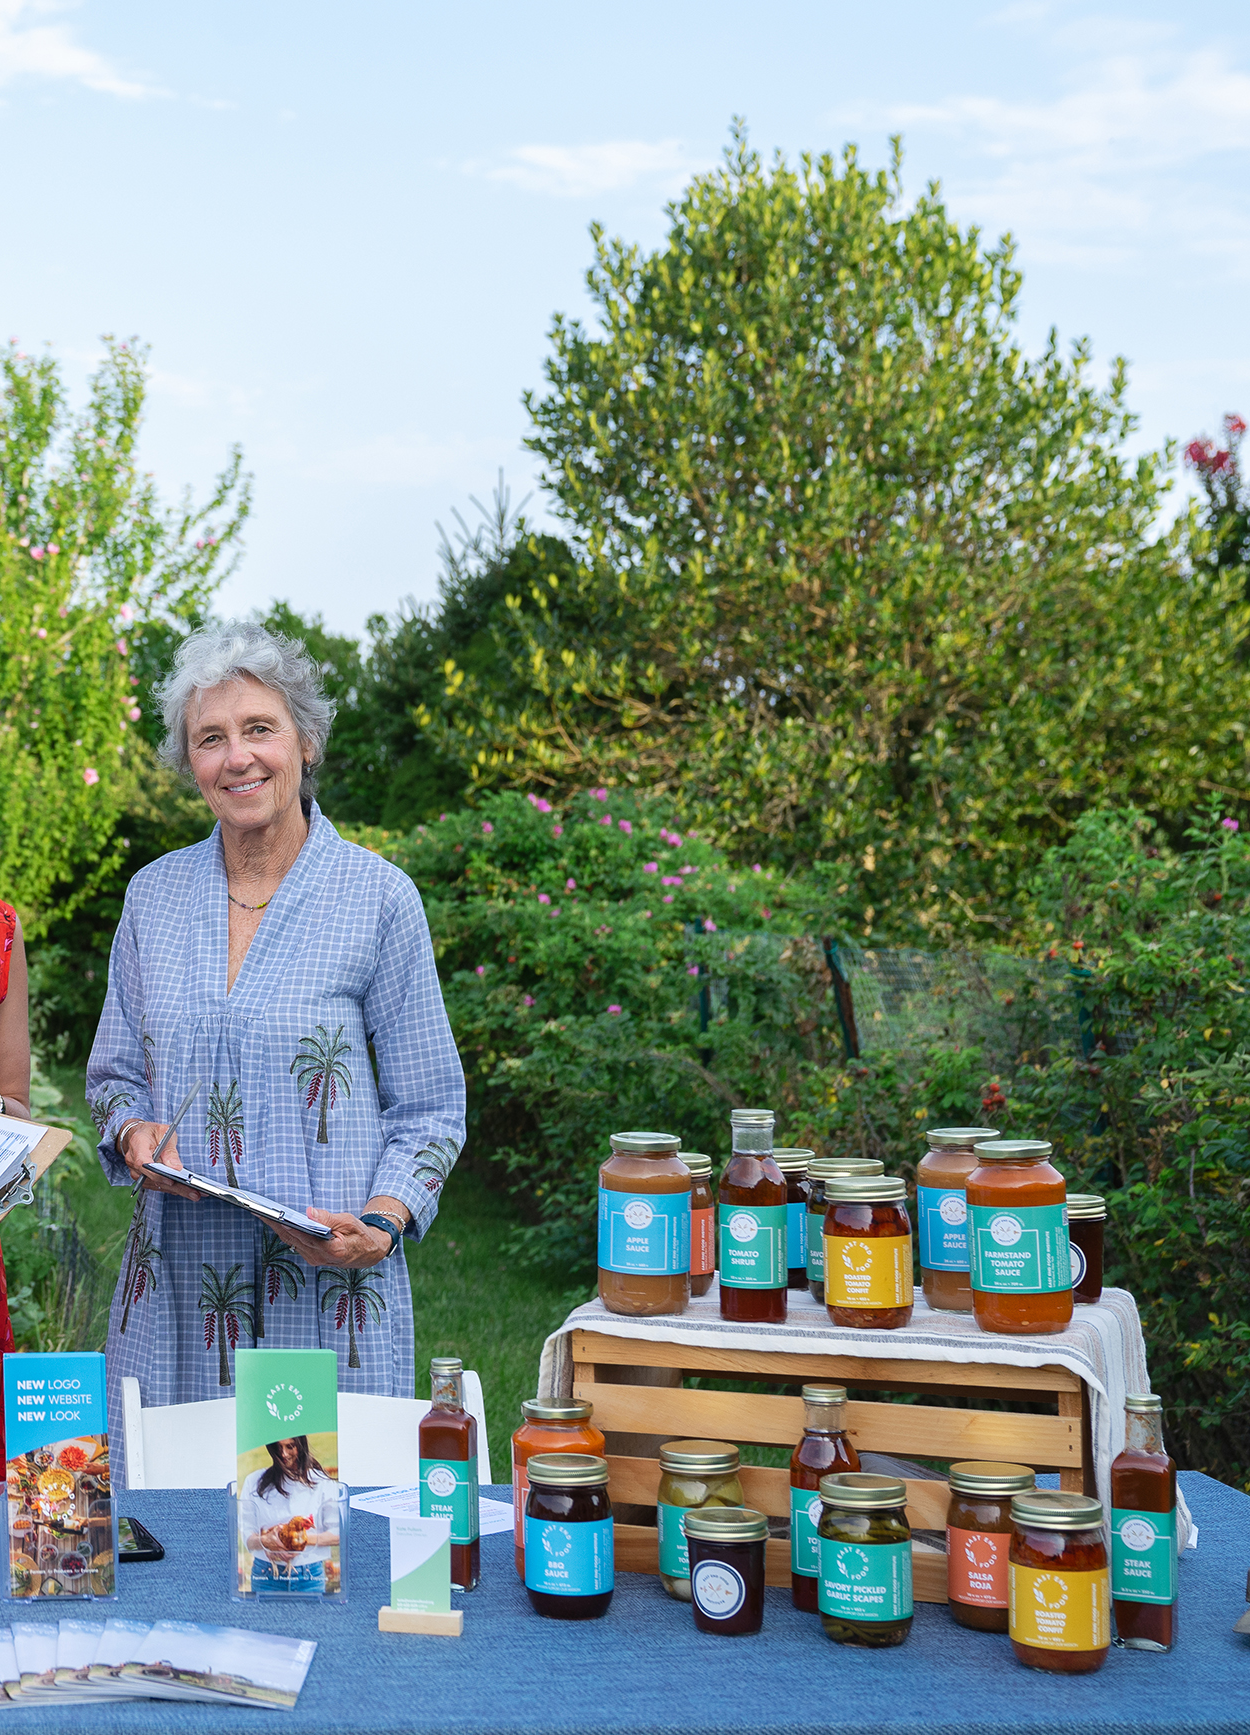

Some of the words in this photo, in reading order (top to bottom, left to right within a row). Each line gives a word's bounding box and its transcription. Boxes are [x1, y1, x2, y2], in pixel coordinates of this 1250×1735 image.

[626, 1237, 649, 1245] APPLE
[943, 1233, 966, 1241] APPLE
[626, 1245, 650, 1253] SAUCE
[842, 1241, 857, 1254] EAST
[859, 1242, 872, 1255] END
[943, 1241, 967, 1249] SAUCE
[728, 1249, 759, 1258] TOMATO
[984, 1251, 1031, 1259] FARMSTAND
[731, 1258, 756, 1266] SHRUB
[811, 1258, 824, 1266] GAR
[856, 1258, 873, 1272] FOOD
[990, 1260, 1025, 1268] TOMATO
[17, 1380, 45, 1390] NEW
[48, 1379, 81, 1390] LOGO
[266, 1383, 285, 1399] EAST
[288, 1385, 302, 1400] END
[17, 1395, 46, 1405] NEW
[48, 1394, 93, 1405] WEBSITE
[18, 1411, 46, 1422] NEW
[50, 1410, 81, 1421] LOOK
[283, 1404, 303, 1422] FOOD
[40, 1482, 57, 1498] EAST
[61, 1484, 75, 1499] END
[57, 1504, 75, 1521] FOOD
[430, 1504, 453, 1512] STEAK
[430, 1512, 454, 1521] SAUCE
[542, 1524, 556, 1537] EAST
[559, 1526, 571, 1540] END
[965, 1534, 981, 1547] EAST
[983, 1537, 997, 1551] END
[555, 1543, 572, 1557] FOOD
[837, 1546, 852, 1559] EAST
[855, 1548, 869, 1563] END
[548, 1560, 565, 1570] BBQ
[979, 1554, 997, 1568] FOOD
[1124, 1559, 1151, 1569] STEAK
[544, 1569, 569, 1578] SAUCE
[851, 1566, 869, 1580] FOOD
[968, 1571, 994, 1582] SALSA
[1123, 1568, 1152, 1579] SAUCE
[824, 1579, 851, 1592] SAVORY
[853, 1585, 887, 1595] PICKLED
[969, 1580, 992, 1590] ROJA
[1033, 1574, 1050, 1588] EAST
[1053, 1576, 1068, 1591] END
[826, 1589, 851, 1601] GARLIC
[852, 1593, 884, 1604] SCAPES
[1049, 1593, 1068, 1609] FOOD
[1035, 1617, 1066, 1627] TOMATO
